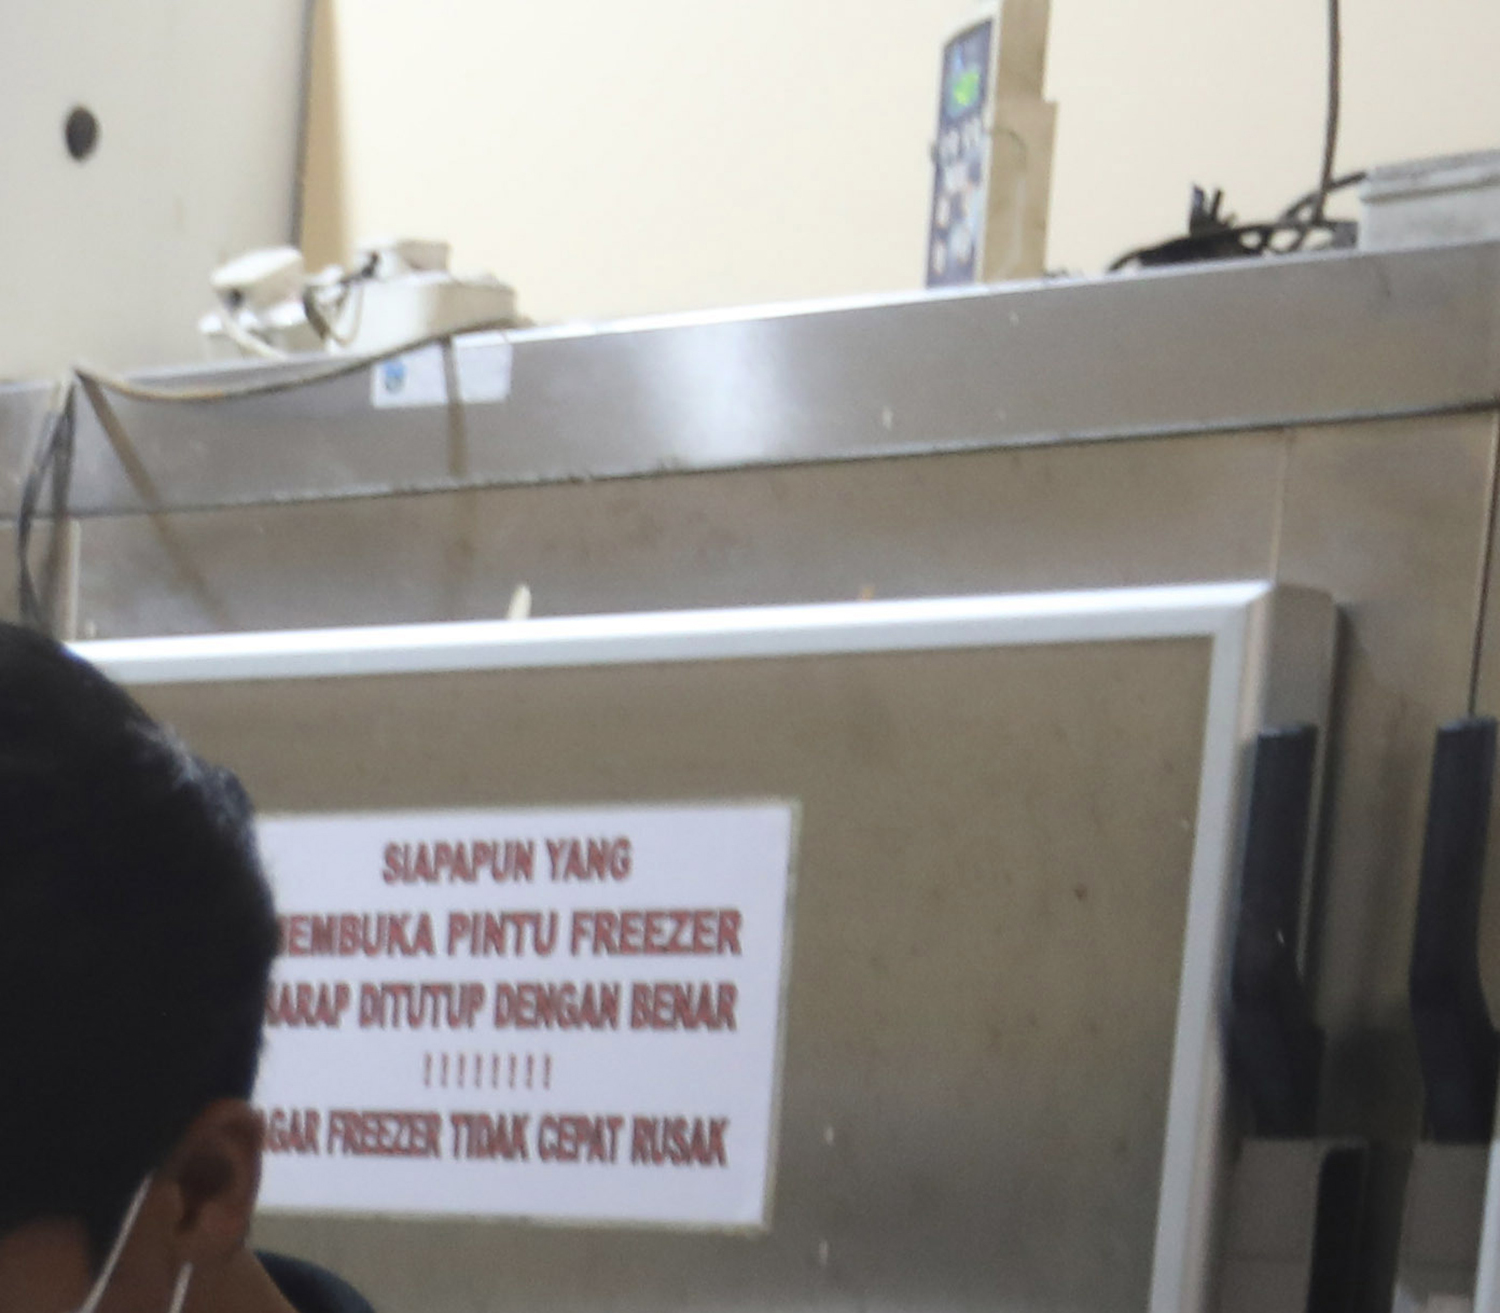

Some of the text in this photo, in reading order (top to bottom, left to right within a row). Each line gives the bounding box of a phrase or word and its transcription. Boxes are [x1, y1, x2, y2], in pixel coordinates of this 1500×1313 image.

[383, 837, 633, 885] SIAPAPUN YANG
[448, 911, 559, 957] PINTU
[570, 909, 742, 957] FREEZER
[359, 982, 486, 1030] DITUTUP
[494, 981, 620, 1031] DENGAN
[630, 981, 738, 1031] BENAR
[328, 1110, 442, 1158] FREEZER
[449, 1113, 529, 1161] TIDAK
[538, 1113, 625, 1163] CEPAT
[631, 1115, 728, 1167] RUSAK
